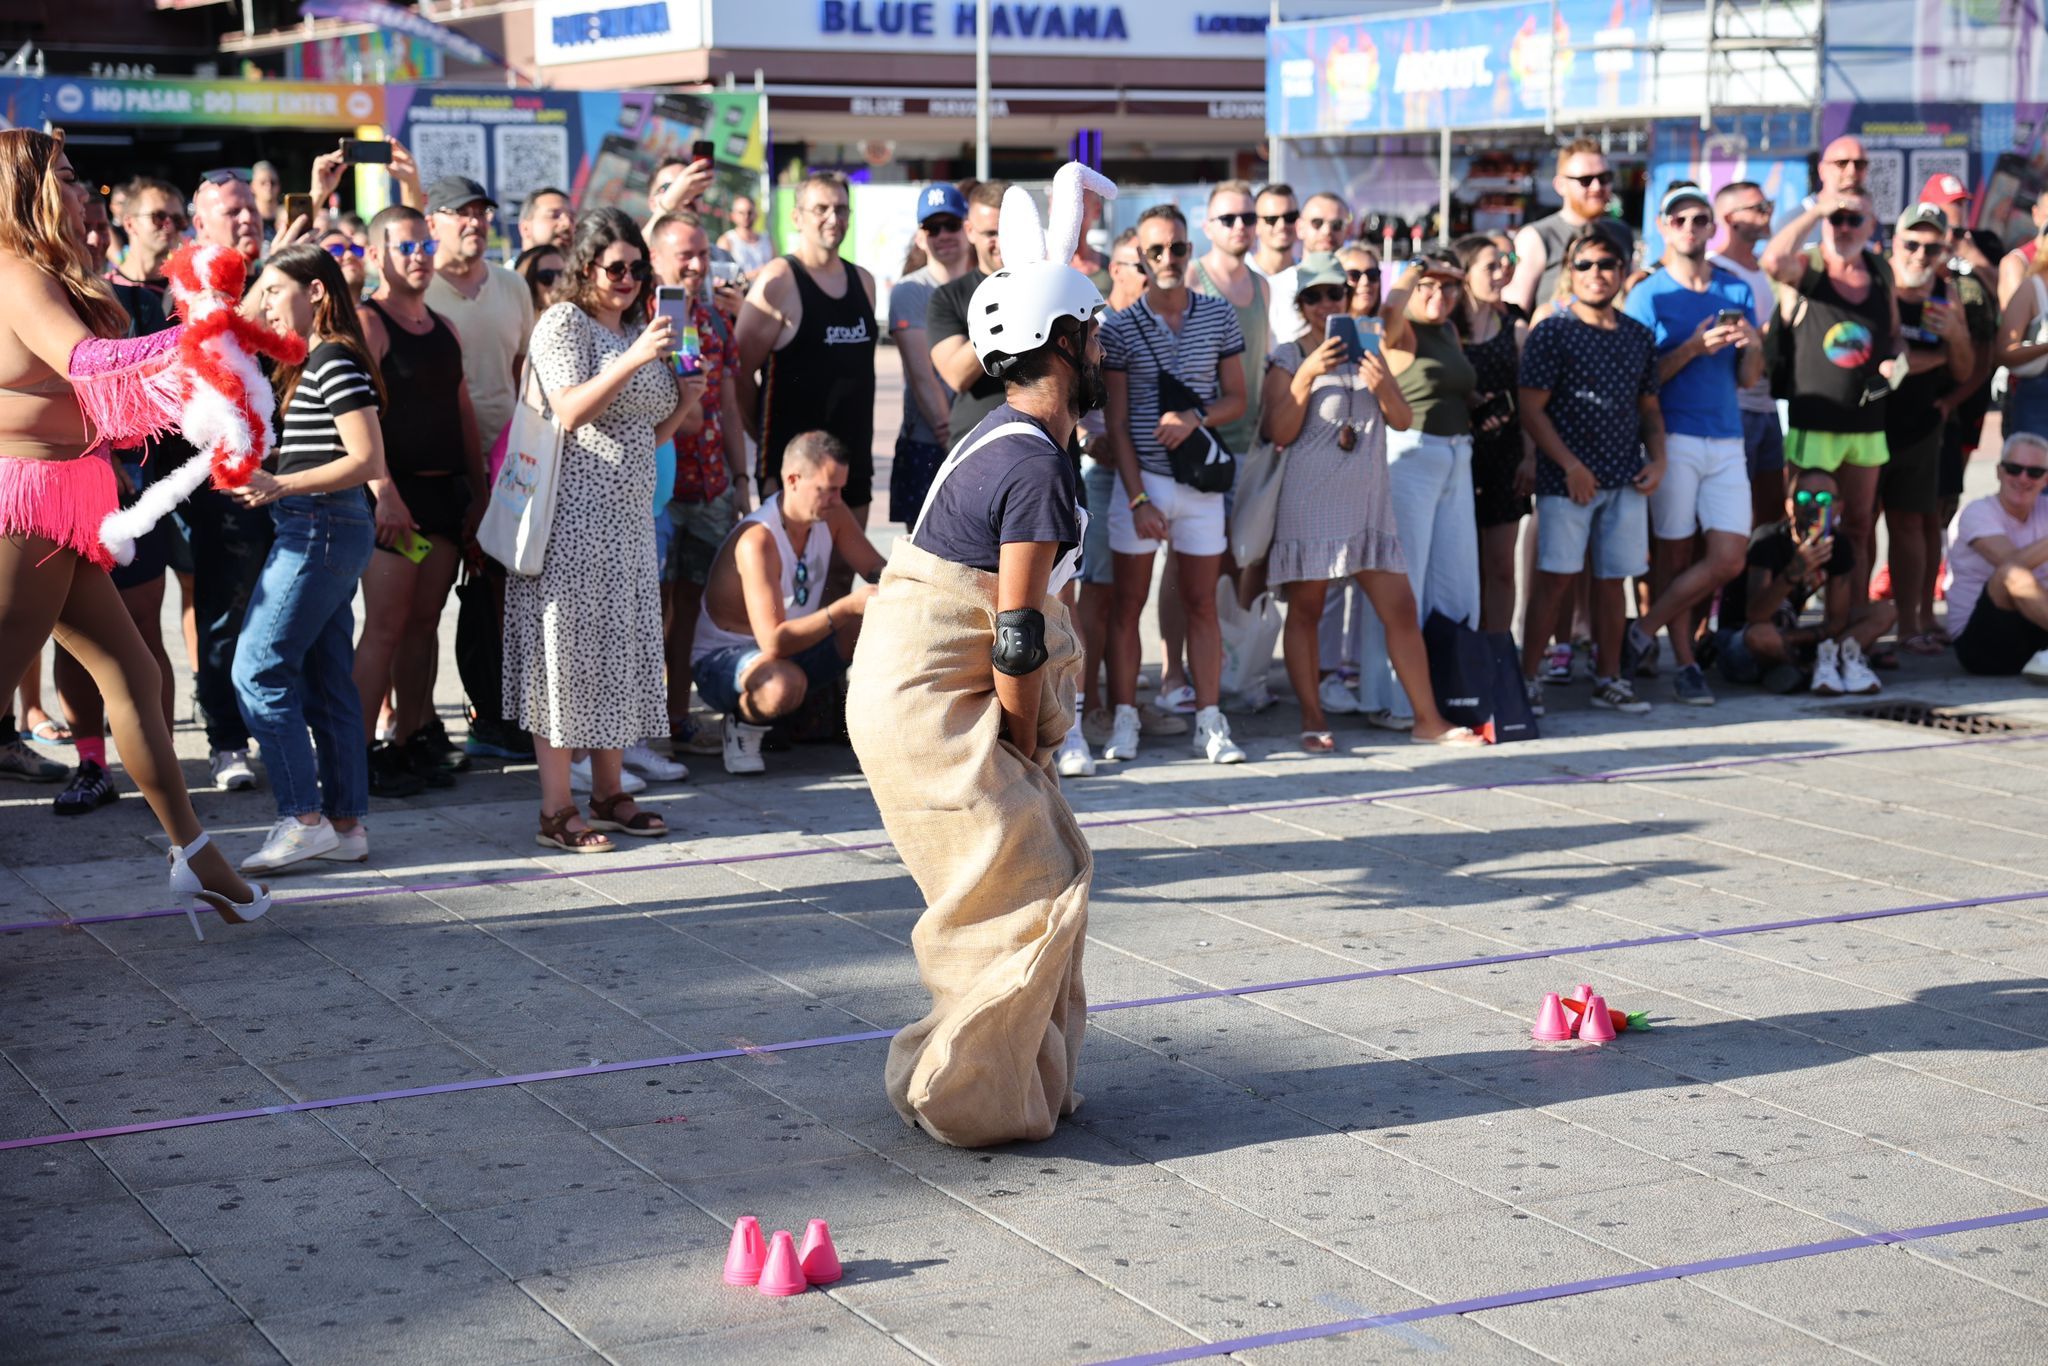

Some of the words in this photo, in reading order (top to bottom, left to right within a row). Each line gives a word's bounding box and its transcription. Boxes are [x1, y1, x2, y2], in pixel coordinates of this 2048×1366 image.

[820, 0, 935, 36] BLUE
[954, 2, 1128, 40] HAVANA
[92, 88, 122, 112] NO
[124, 89, 192, 114] PASAR
[204, 90, 234, 115] DO
[851, 97, 904, 116] BLUE
[825, 316, 868, 346] proud
